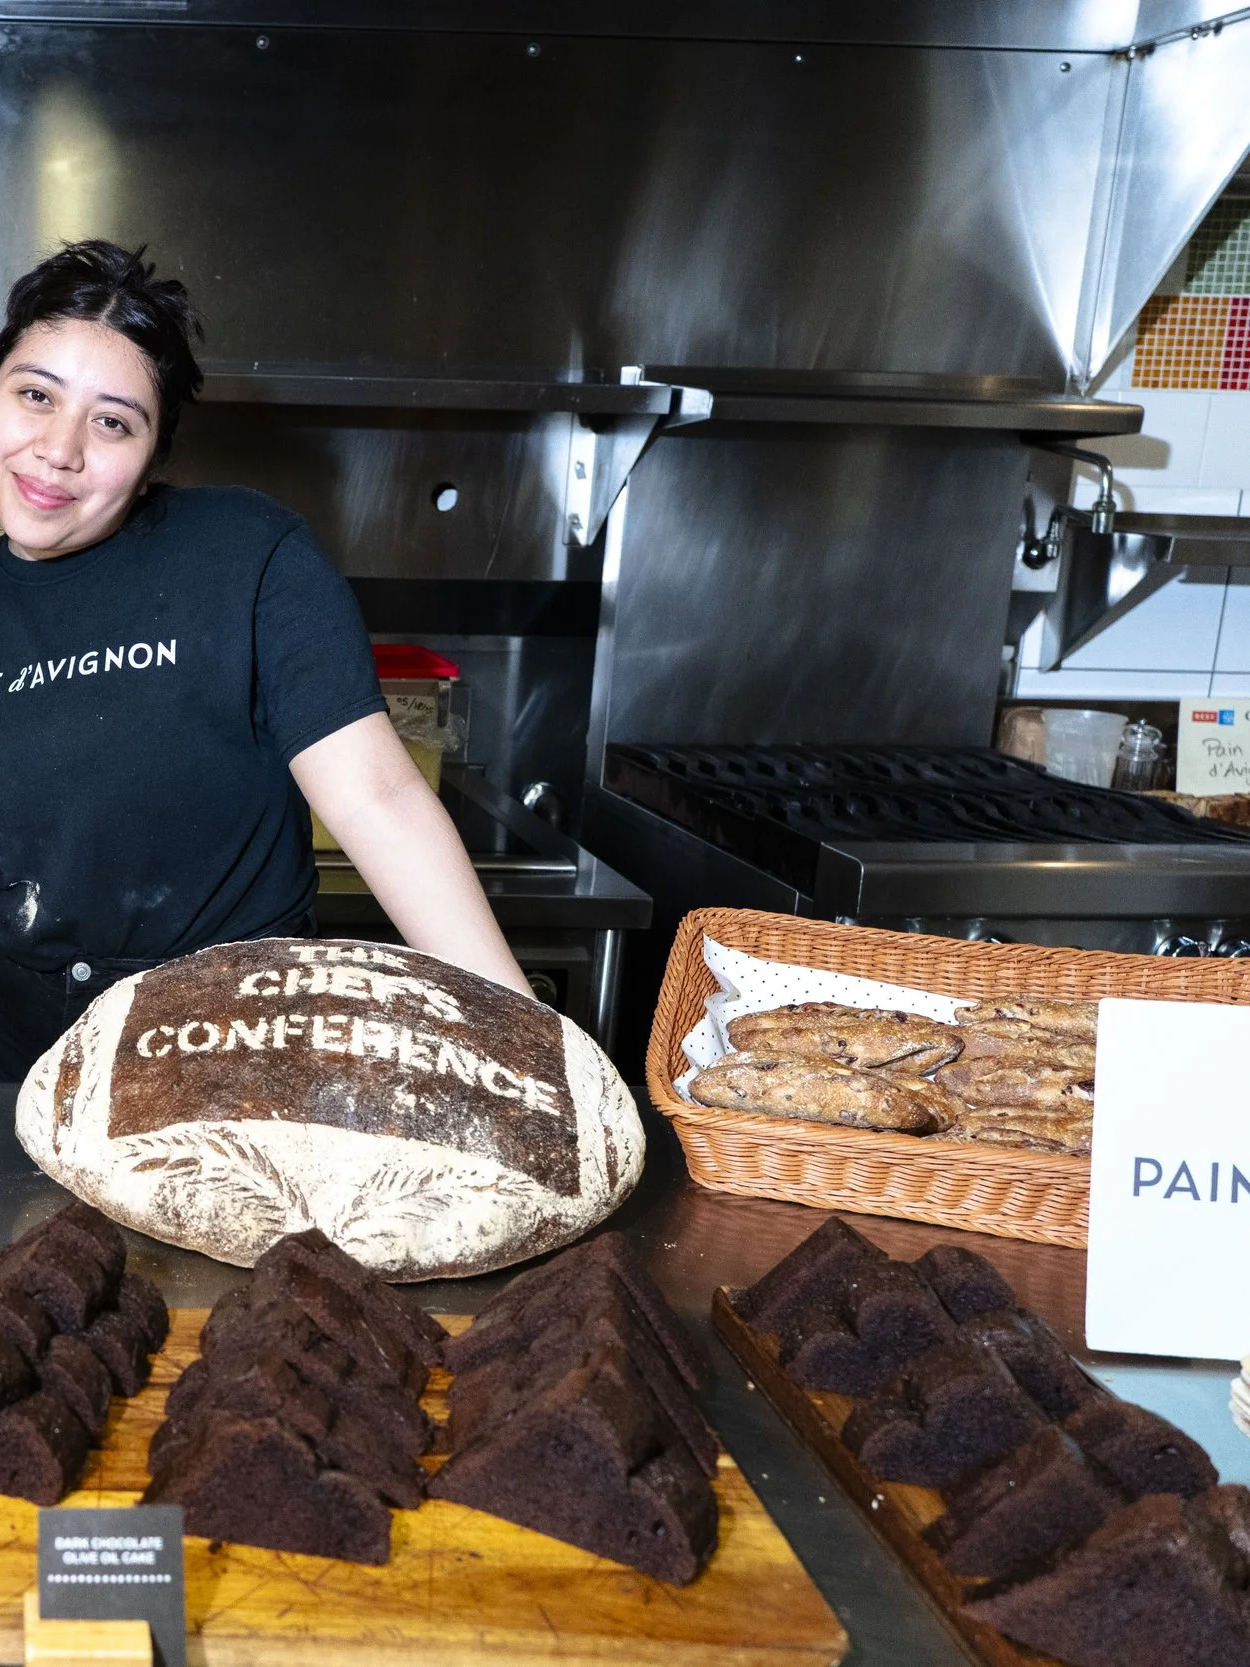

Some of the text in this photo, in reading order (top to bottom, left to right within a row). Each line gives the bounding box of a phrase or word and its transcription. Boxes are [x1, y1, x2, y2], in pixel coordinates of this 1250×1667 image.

[1202, 737, 1243, 758] Pain
[289, 945, 411, 971] THE
[136, 1014, 560, 1116] CONFERENCE
[91, 1536, 163, 1550] CHOCOLATE
